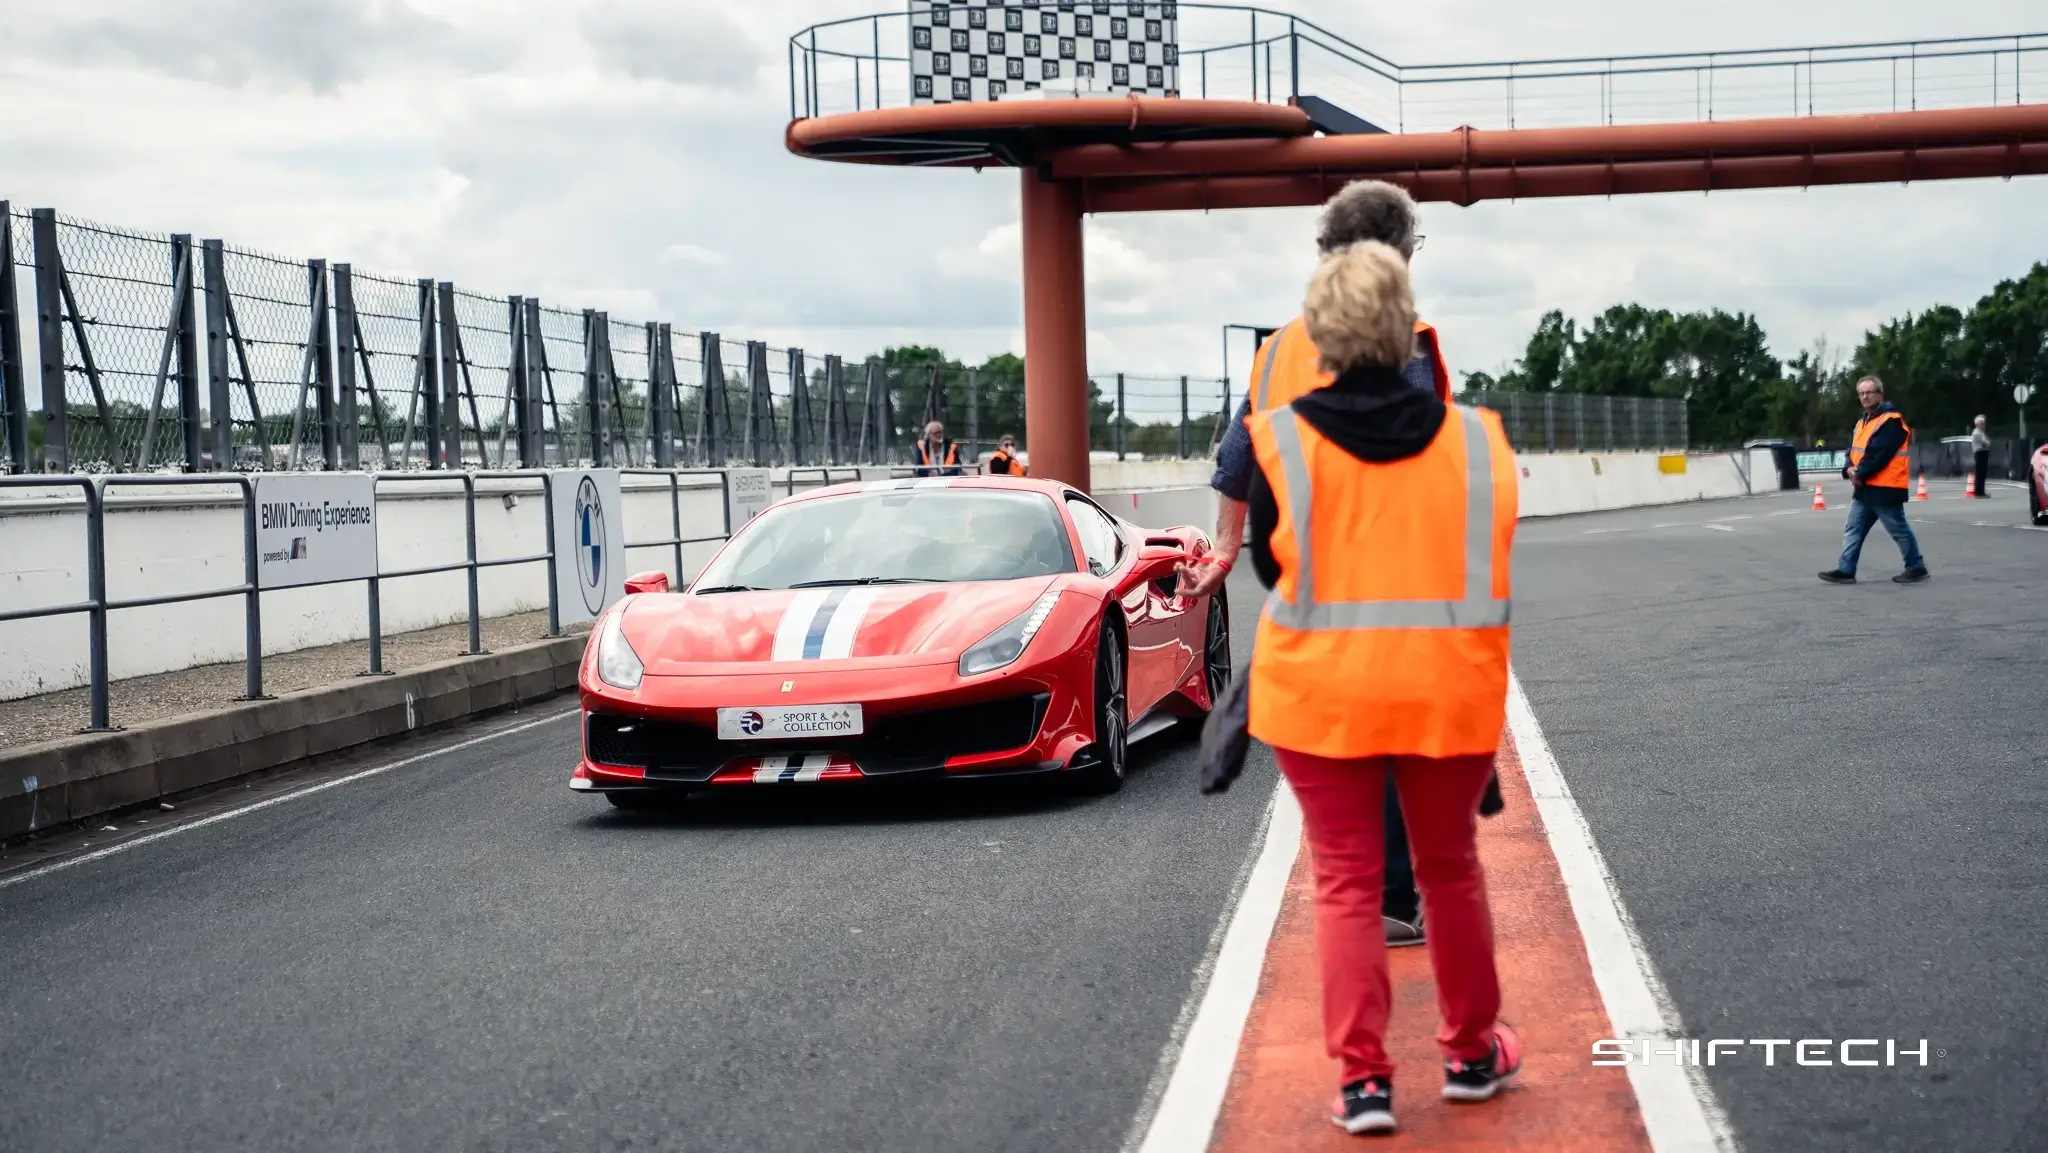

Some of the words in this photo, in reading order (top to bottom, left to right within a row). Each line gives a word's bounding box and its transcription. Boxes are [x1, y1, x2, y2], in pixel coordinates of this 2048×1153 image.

[262, 503, 288, 529] BMW
[290, 501, 322, 532] Driving
[324, 500, 370, 531] Experience
[263, 549, 283, 565] powered
[283, 548, 290, 564] by
[783, 712, 818, 723] SPORT
[820, 712, 829, 721] &
[783, 720, 852, 732] COLLECTION
